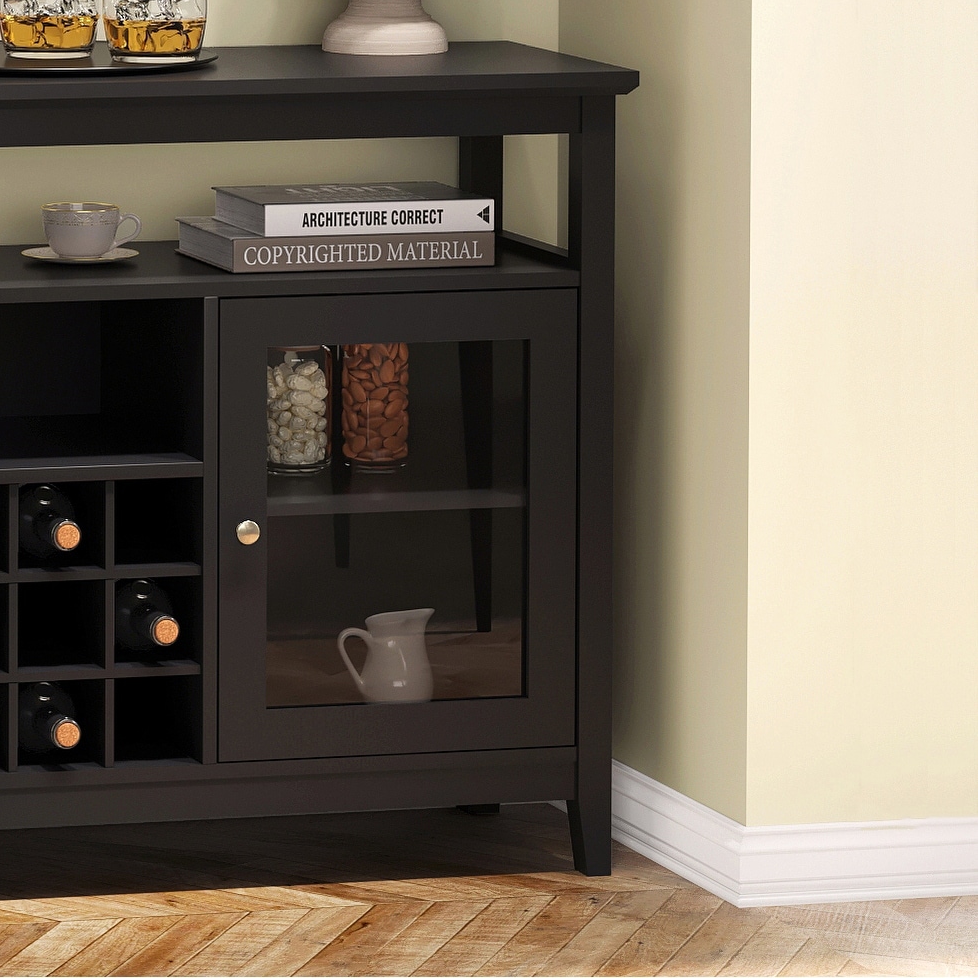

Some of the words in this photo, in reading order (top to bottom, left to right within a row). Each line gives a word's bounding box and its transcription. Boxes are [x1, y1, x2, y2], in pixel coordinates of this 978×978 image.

[301, 210, 388, 228] ARCHITECTURE
[391, 208, 444, 225] CORRECT
[243, 242, 382, 266] COPYRIGHTED
[386, 240, 484, 262] MATERIAL
